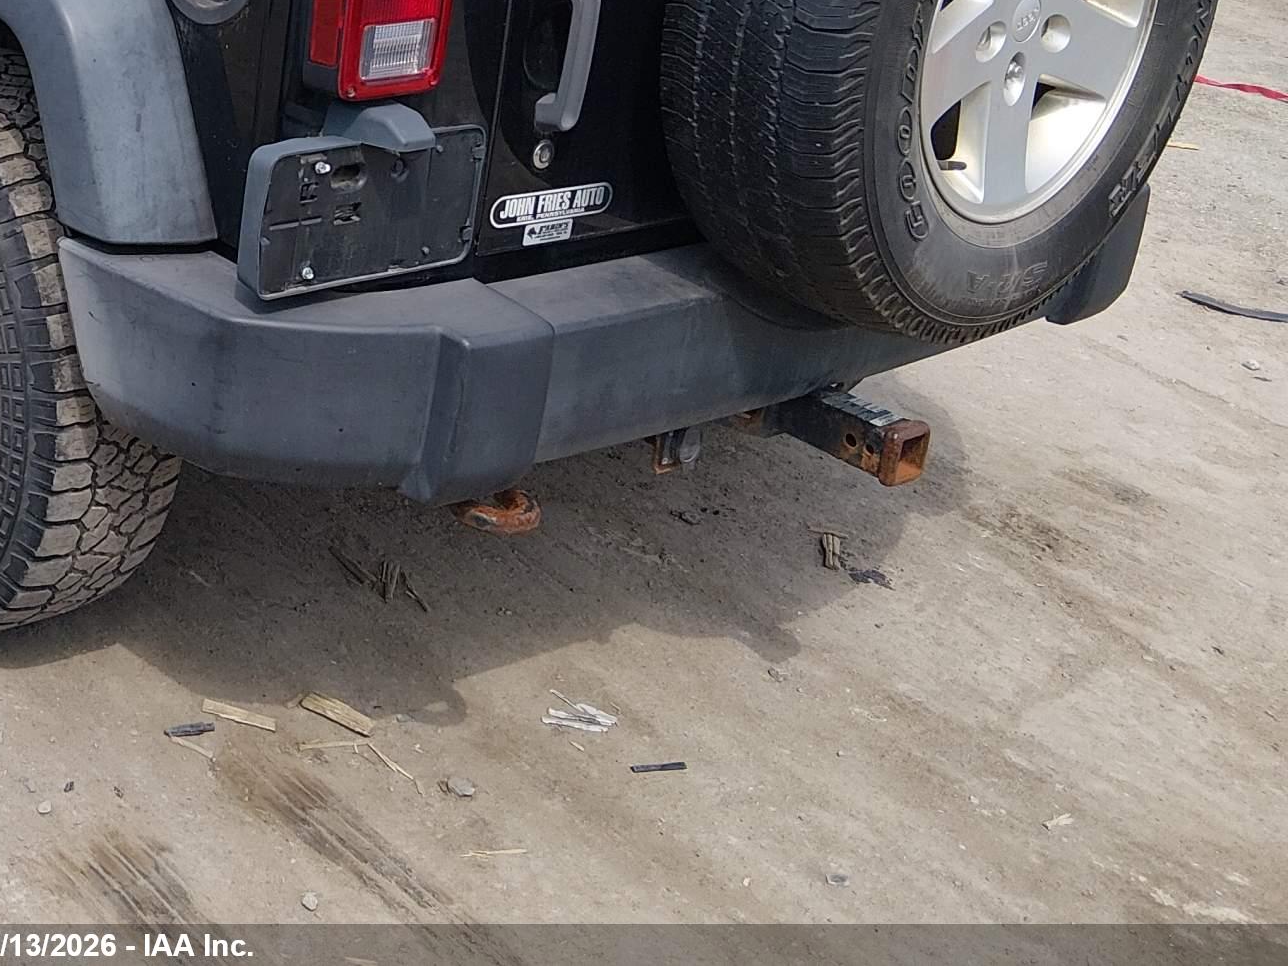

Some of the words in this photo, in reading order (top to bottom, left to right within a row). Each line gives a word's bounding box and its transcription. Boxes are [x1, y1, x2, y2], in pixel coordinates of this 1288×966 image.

[499, 197, 536, 219] JOHN
[537, 191, 572, 213] FRIES
[573, 186, 605, 208] AUTO
[536, 208, 585, 220] PENNSYLVANIA
